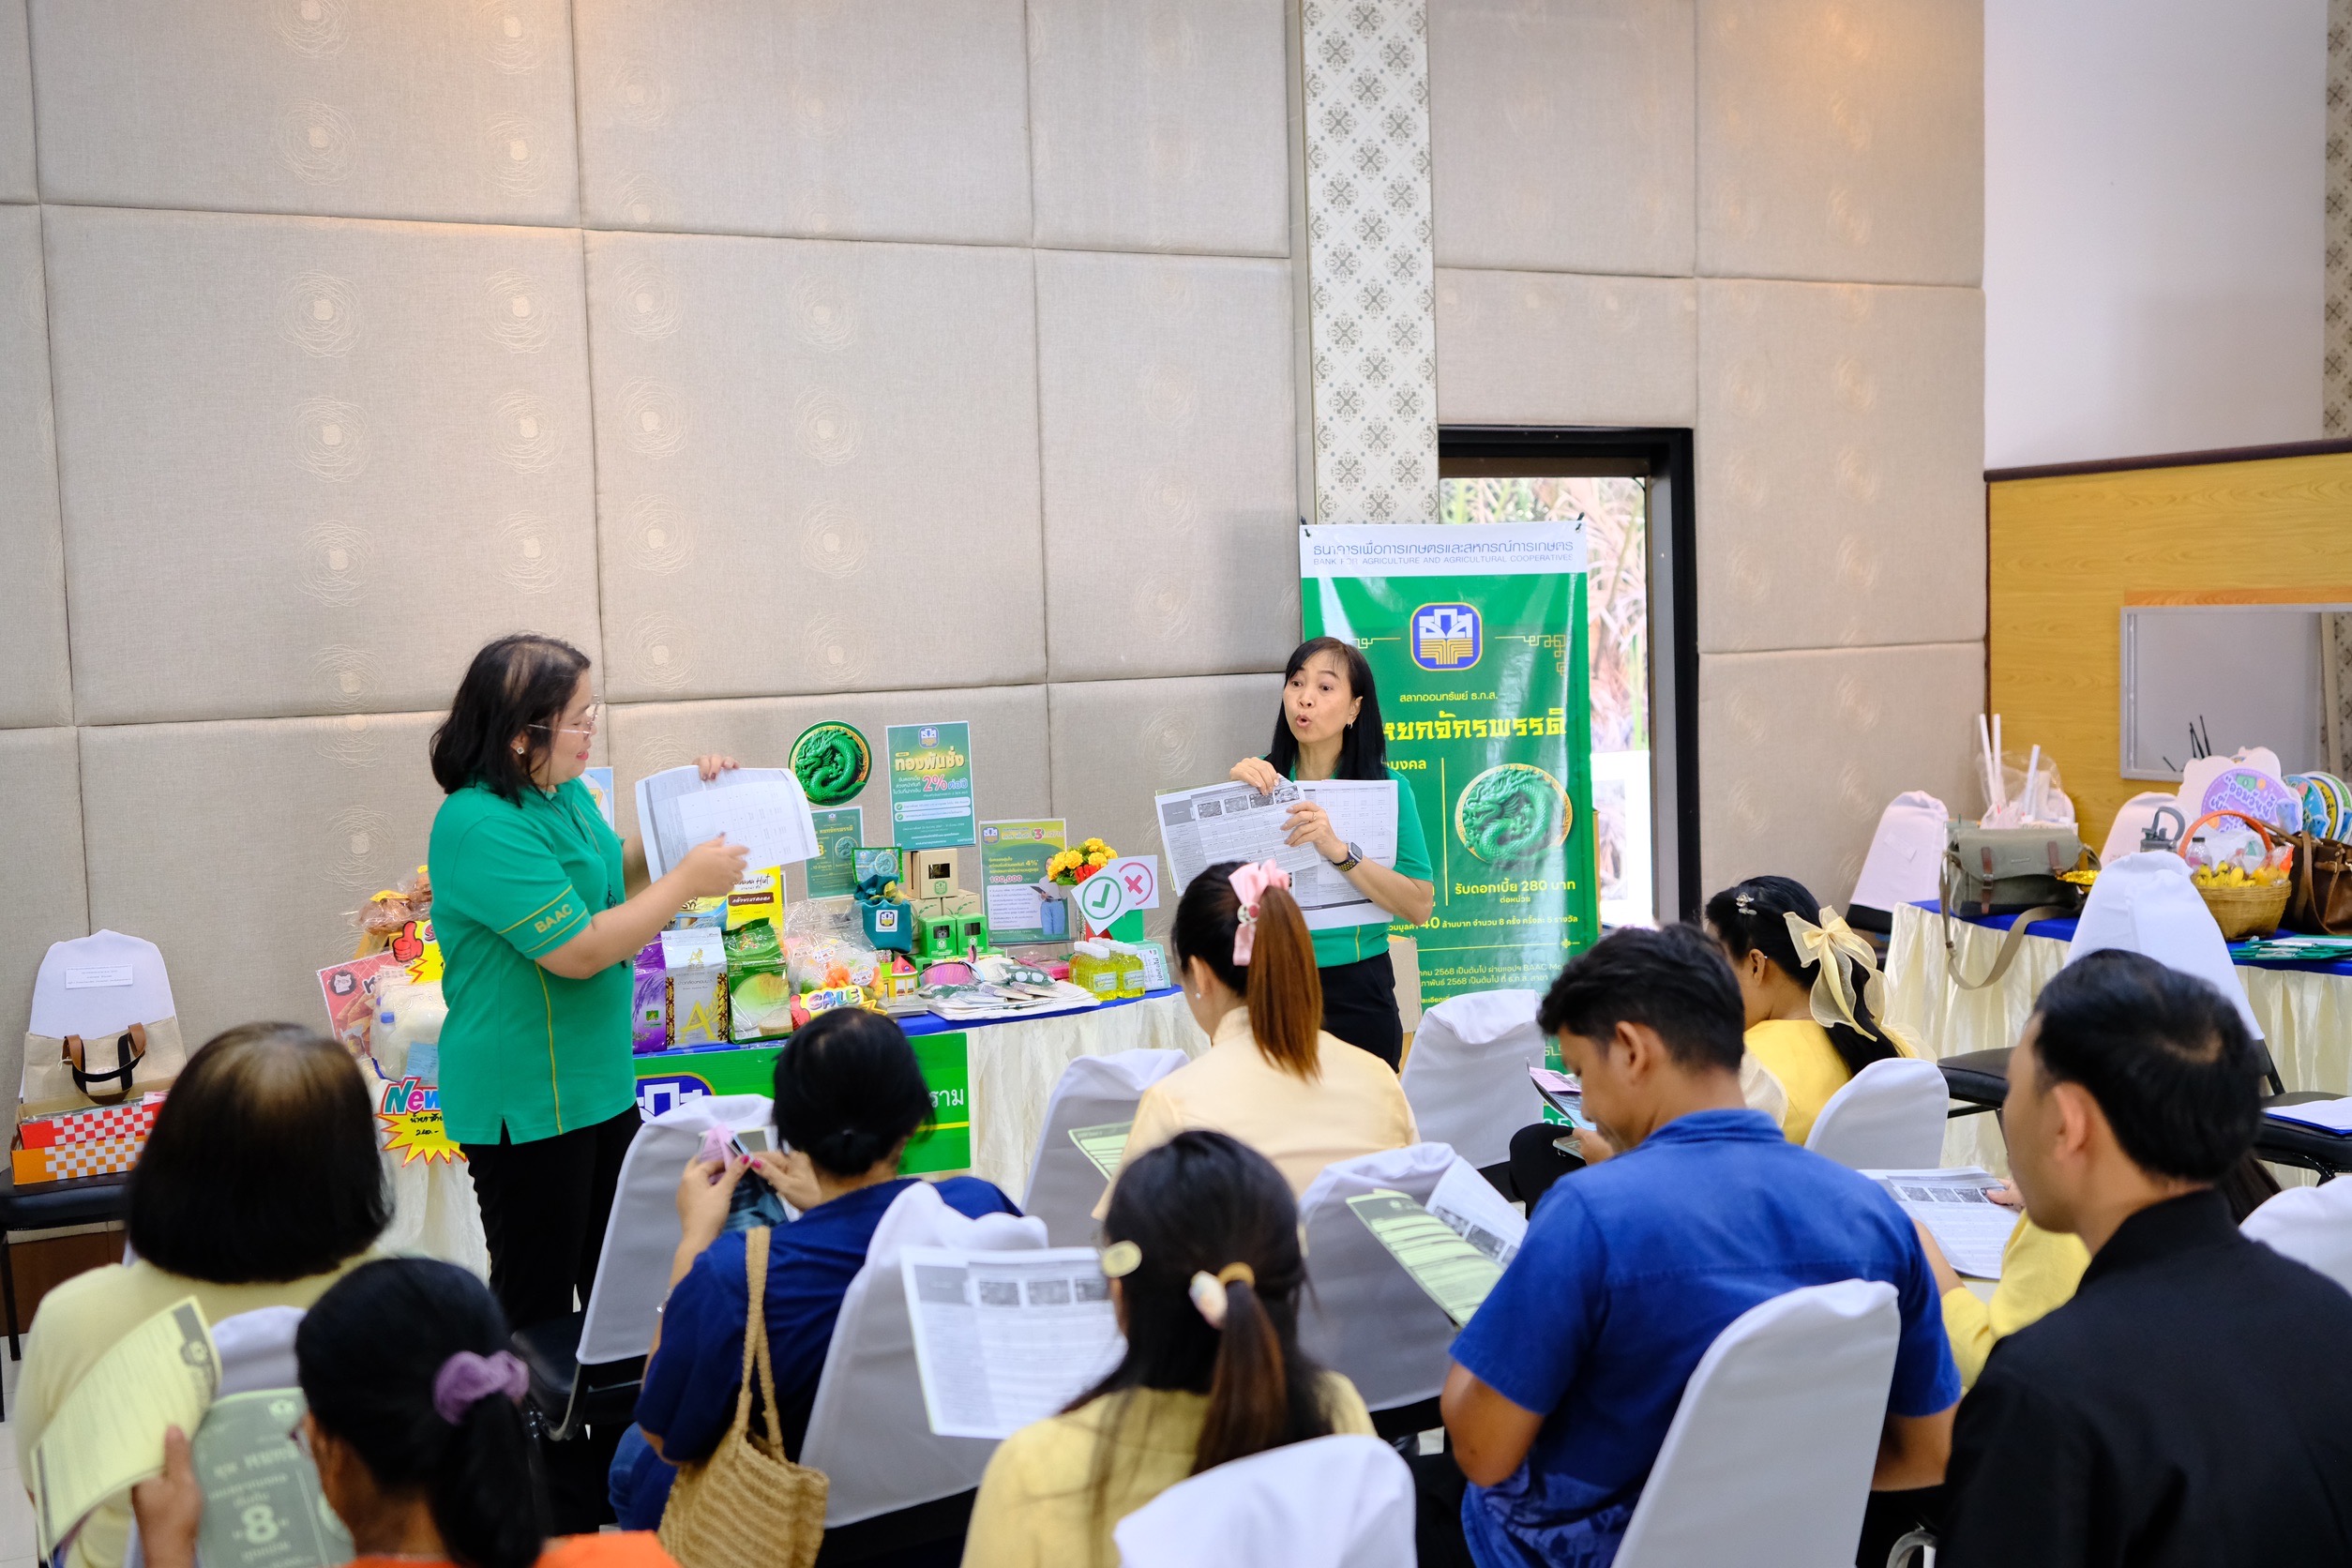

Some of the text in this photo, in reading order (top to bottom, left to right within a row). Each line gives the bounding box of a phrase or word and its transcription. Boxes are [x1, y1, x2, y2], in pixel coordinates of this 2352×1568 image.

[1314, 540, 1574, 555] ธนาคารเพื่อการเกษตรและสหกรณ์การเกษตร
[1363, 557, 1420, 565] AGRICULTURE
[1423, 556, 1441, 565] AND
[1444, 555, 1507, 564] AGRICULTURAL
[1510, 553, 1573, 563] COOPERATIVES
[1399, 690, 1499, 702] สลากออมทรัพย์ ธ.ก.ส.
[1386, 759, 1427, 770] มงคล
[923, 774, 948, 792] 2%
[756, 873, 771, 886] Hut
[1455, 878, 1576, 896] รับดอกเบี้ย 280 บาท
[534, 903, 573, 933] BAAC
[1421, 916, 1440, 929] 40
[1441, 919, 1471, 928] ล้านบาท
[1472, 918, 1499, 927] จำนวน
[1506, 915, 1521, 926] ครั้ง
[1434, 968, 1455, 976] 2568
[1456, 965, 1487, 975] เป็นต้นไป
[1523, 963, 1547, 972] BAAC
[1447, 976, 1468, 986] 2568
[1469, 974, 1500, 985] เป็นต้นไป
[808, 988, 861, 1010] SALE
[241, 1503, 279, 1544] 8
